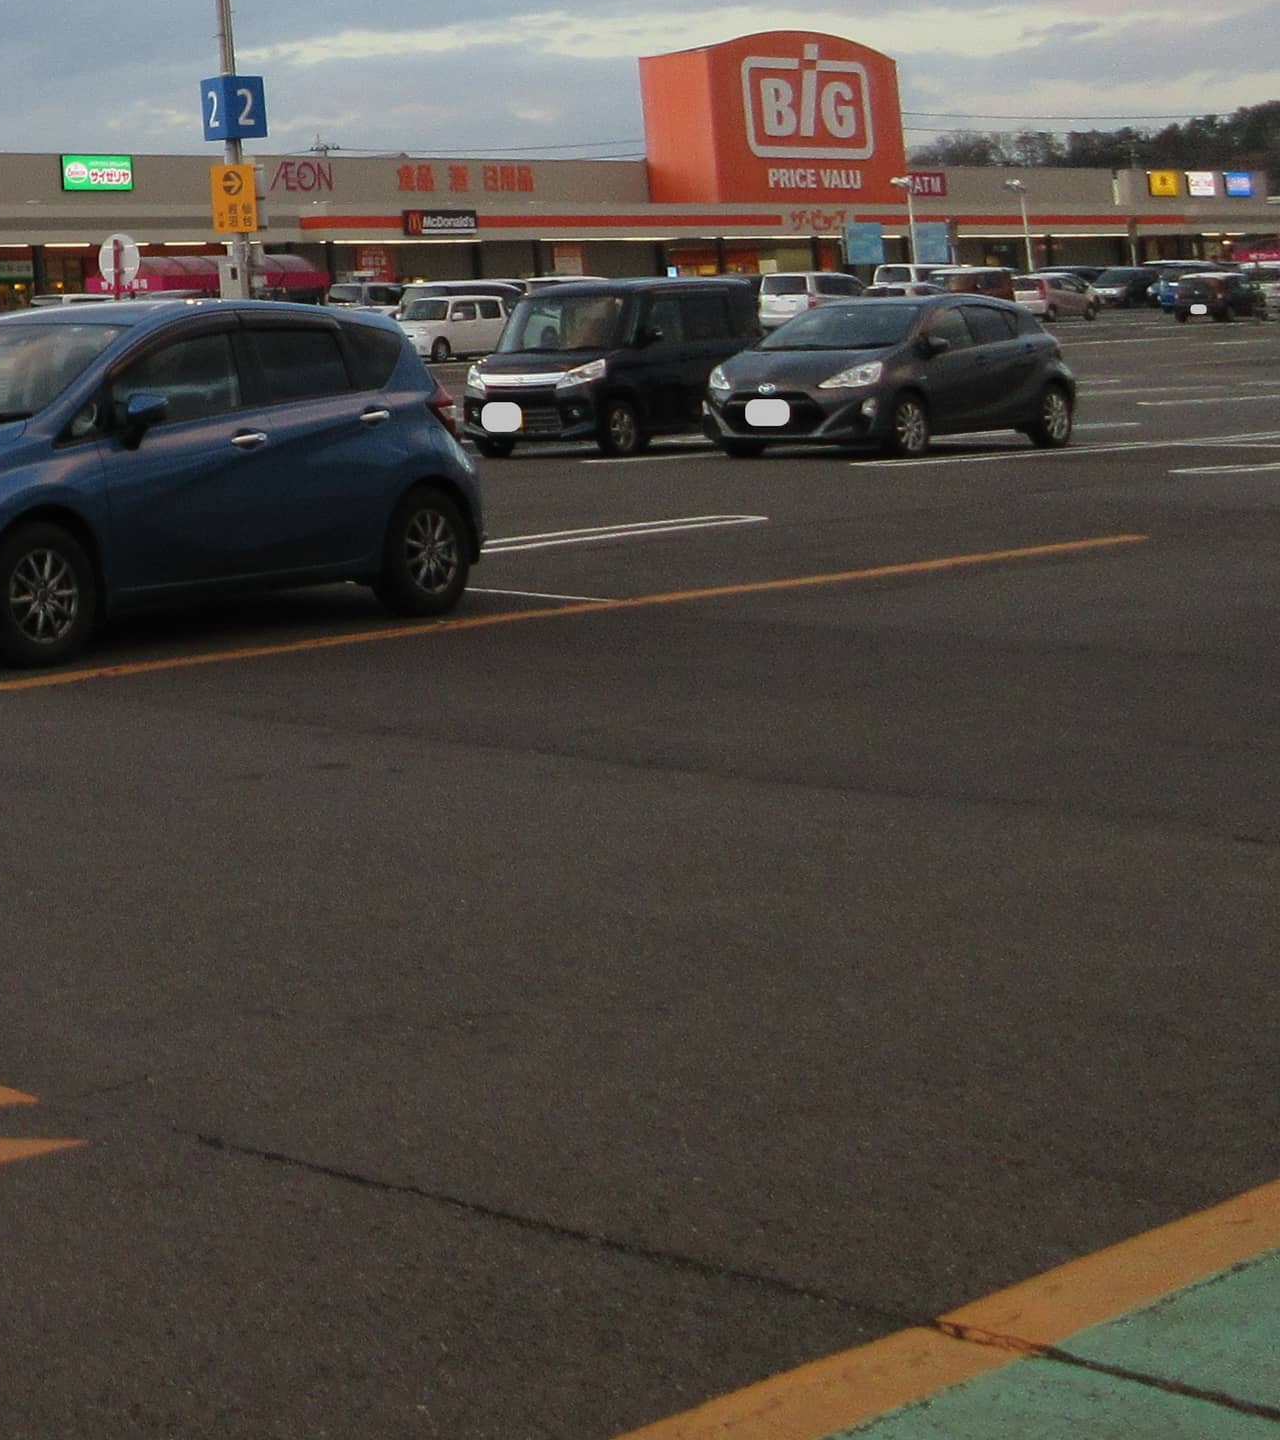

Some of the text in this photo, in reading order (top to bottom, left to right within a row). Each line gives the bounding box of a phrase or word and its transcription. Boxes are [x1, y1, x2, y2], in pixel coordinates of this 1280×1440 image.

[207, 90, 220, 128] 2
[237, 88, 255, 126] 2
[90, 170, 130, 183] サイゼリヤ
[768, 168, 817, 188] PRICE
[423, 216, 475, 228] McDonald's
